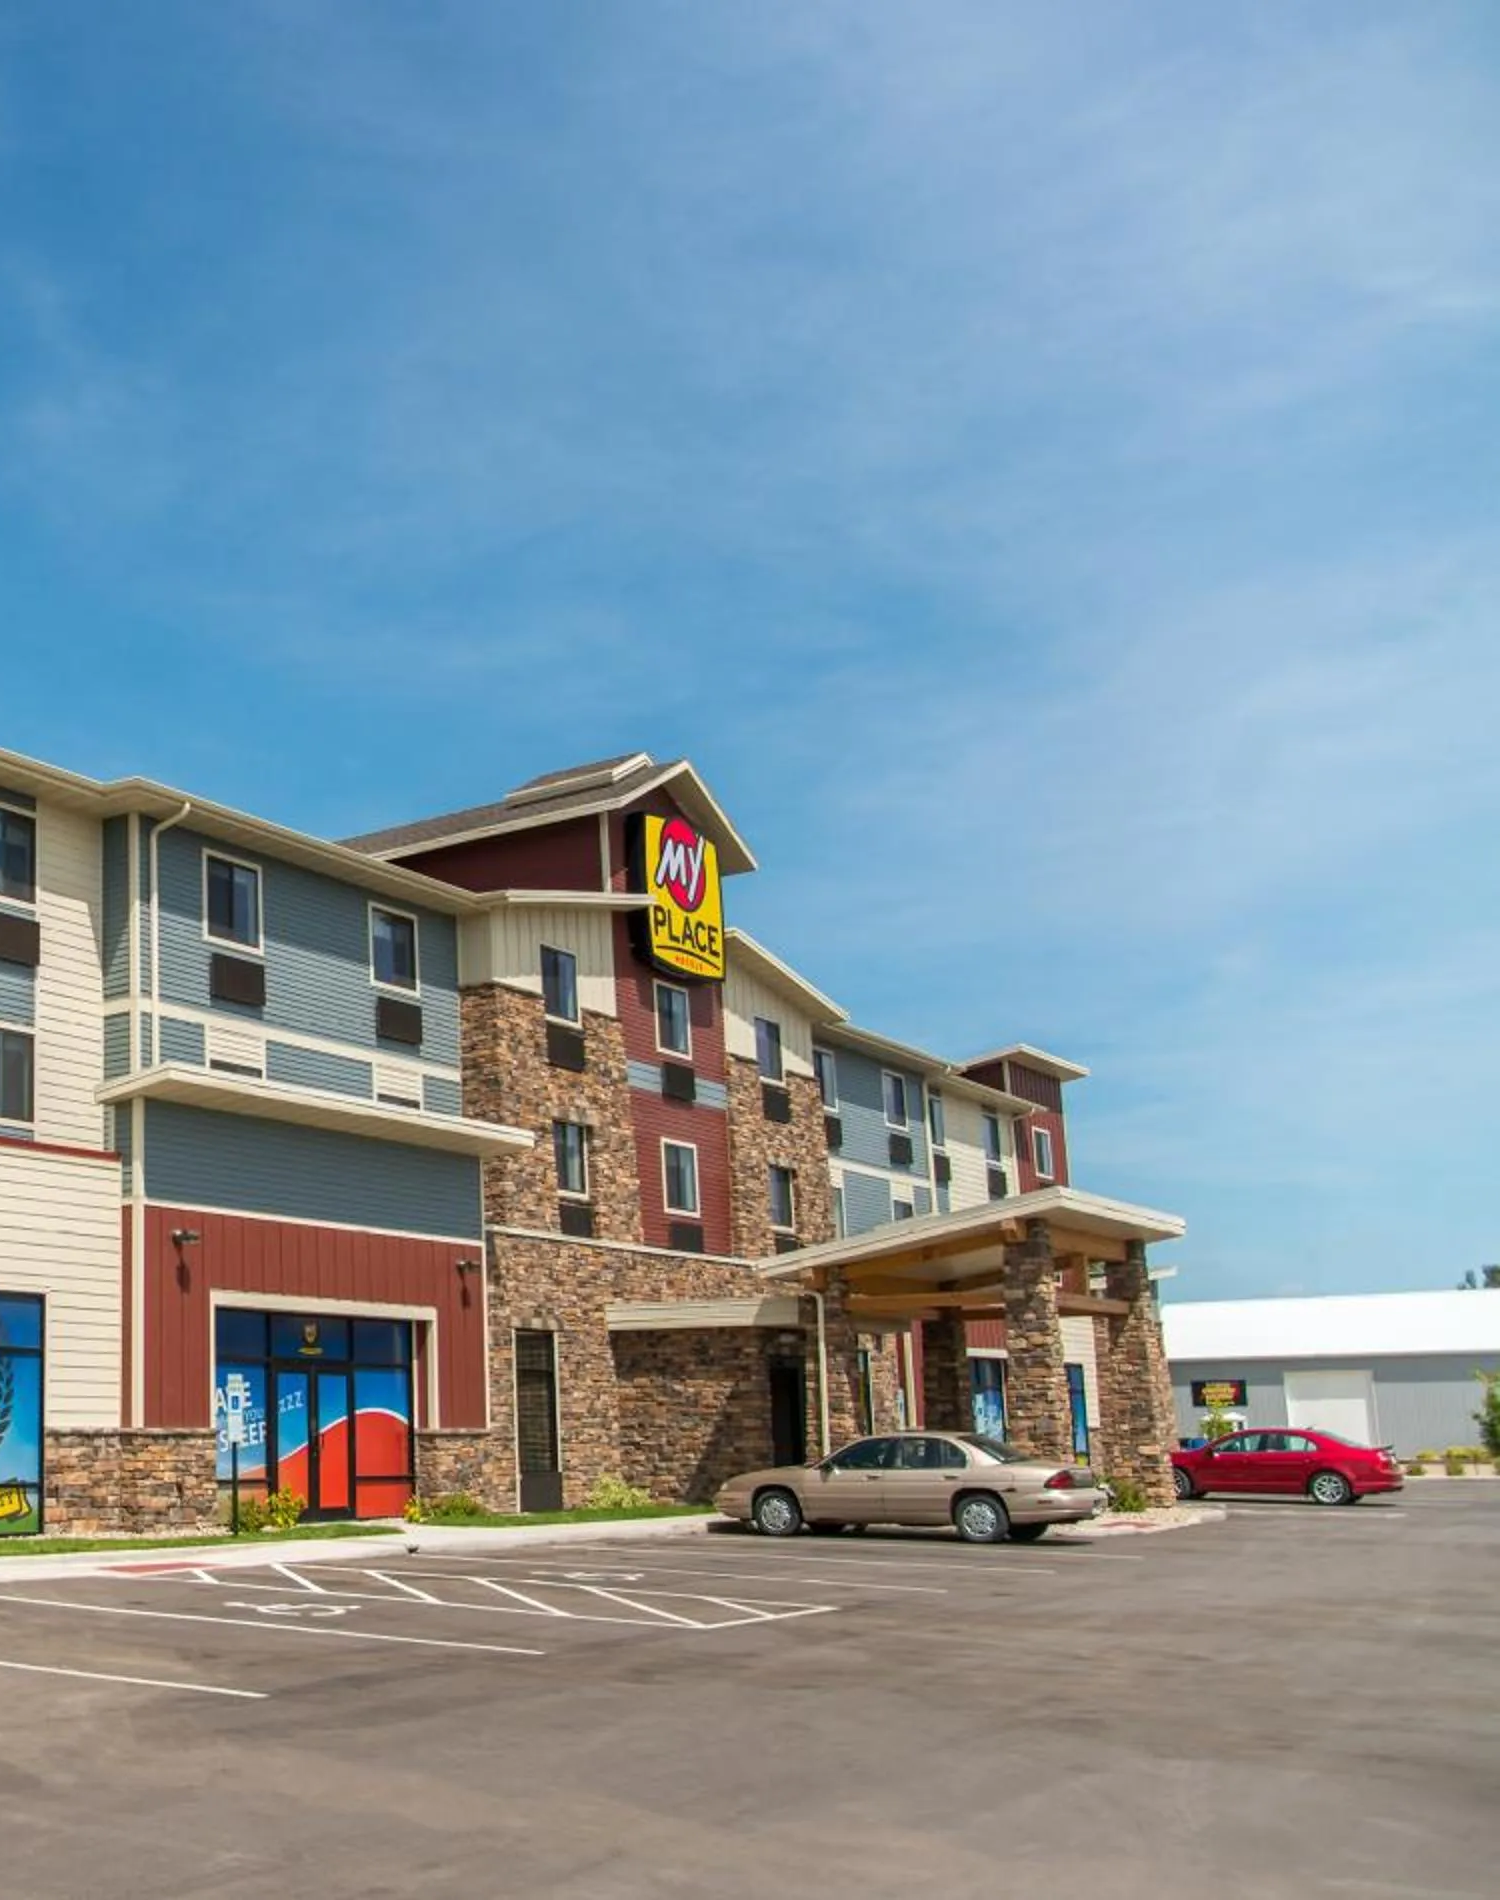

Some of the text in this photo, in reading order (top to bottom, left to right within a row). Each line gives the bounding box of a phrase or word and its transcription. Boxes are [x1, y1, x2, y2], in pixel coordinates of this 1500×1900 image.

[656, 835, 705, 903] MY
[654, 905, 720, 958] PLACE
[218, 1421, 267, 1452] SEEP
